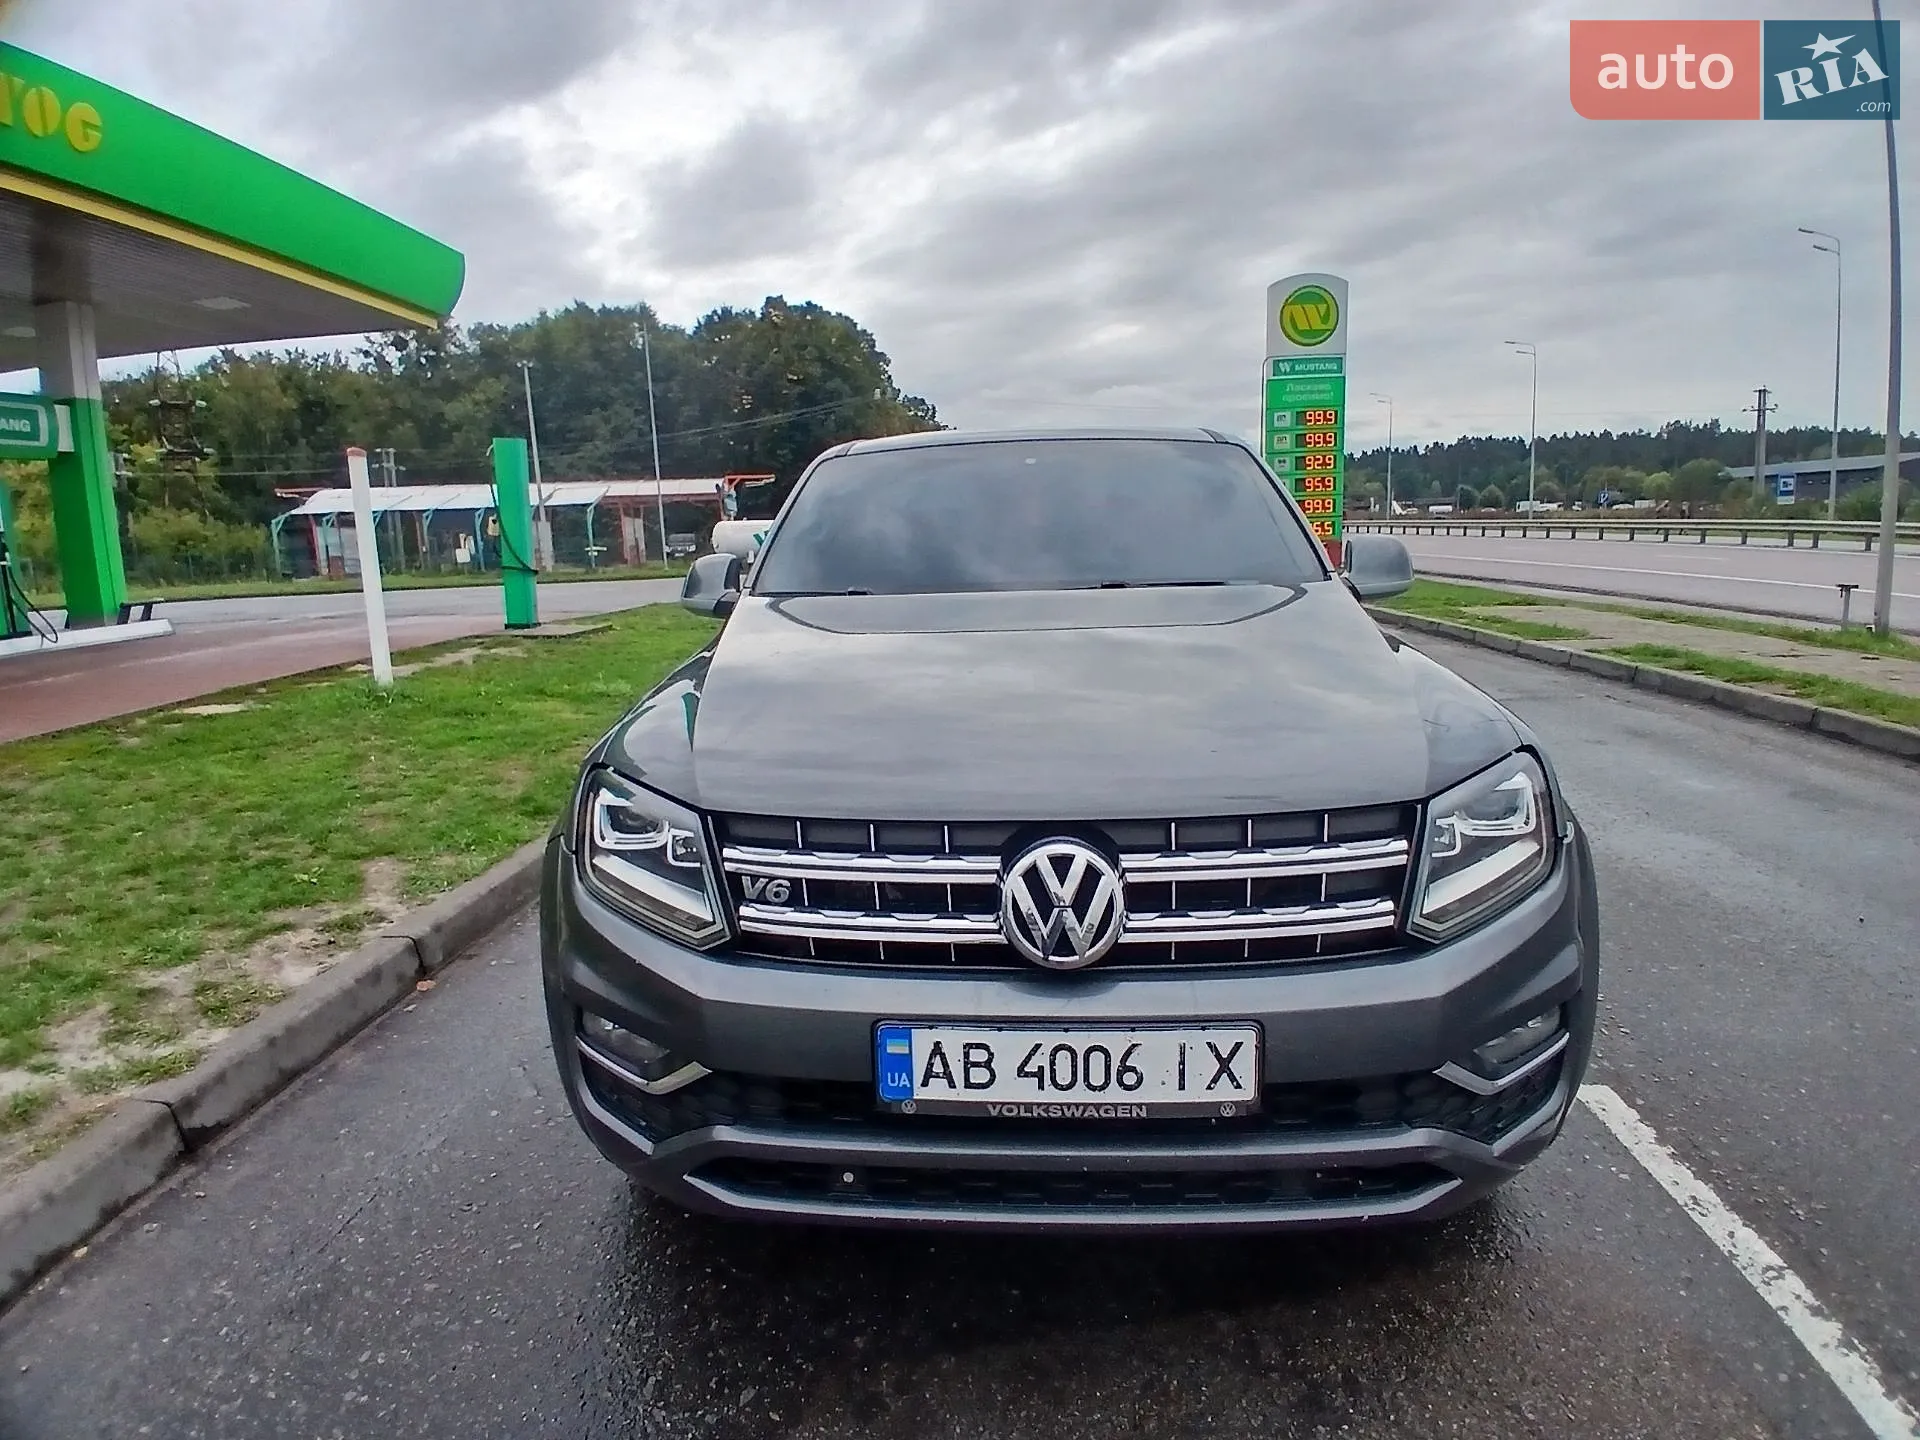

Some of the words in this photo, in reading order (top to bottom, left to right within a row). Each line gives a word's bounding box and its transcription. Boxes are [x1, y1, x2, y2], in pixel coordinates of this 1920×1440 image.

[1294, 362, 1338, 371] MUSTANG
[1306, 410, 1335, 426] 99.9
[1305, 432, 1335, 448] 99.9
[1305, 455, 1334, 470] 92.9
[1305, 477, 1334, 491] 95.9
[1304, 499, 1333, 513] 99.9
[1311, 521, 1333, 535] 5.5
[741, 875, 791, 903] V6
[920, 1040, 997, 1090] AB
[1016, 1042, 1144, 1092] 4006
[887, 1072, 911, 1088] UA
[987, 1103, 1148, 1118] VOLKSWAGEN
